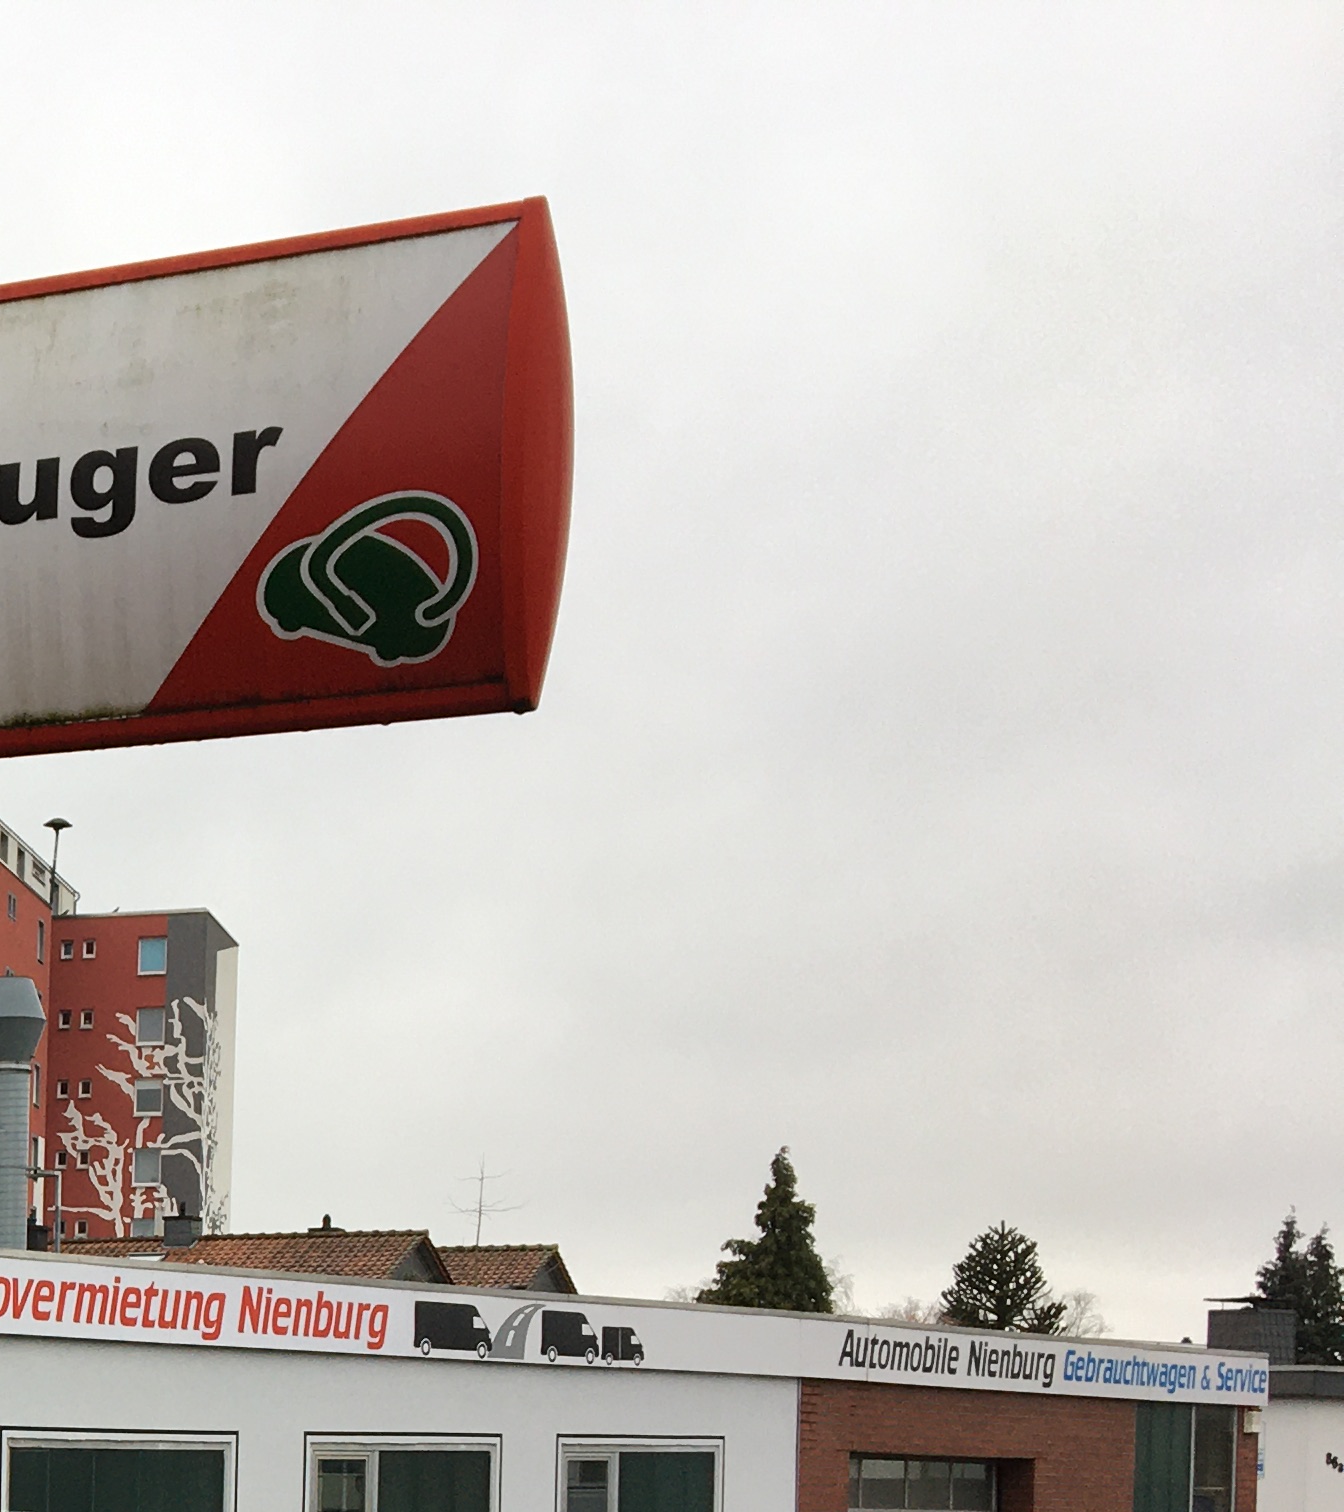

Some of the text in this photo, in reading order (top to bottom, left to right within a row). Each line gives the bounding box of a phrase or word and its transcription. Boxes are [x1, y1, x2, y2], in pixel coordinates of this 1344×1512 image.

[237, 1285, 390, 1350] Nienburg
[838, 1328, 1268, 1394] Automobile Nienburg Gebrauchtwagen & Service
